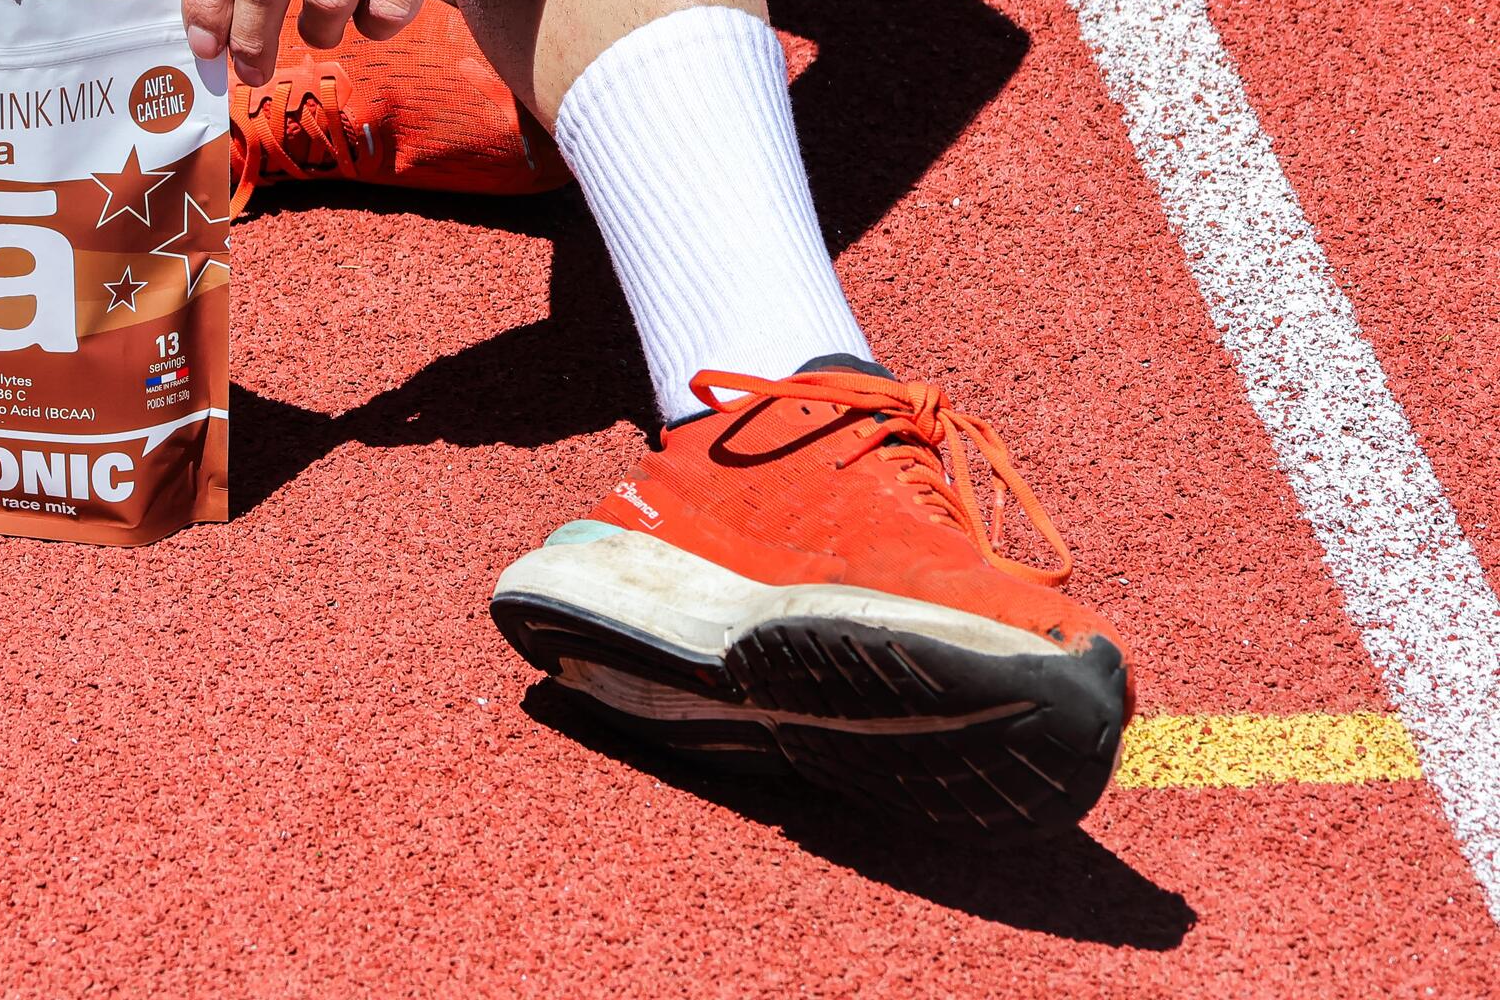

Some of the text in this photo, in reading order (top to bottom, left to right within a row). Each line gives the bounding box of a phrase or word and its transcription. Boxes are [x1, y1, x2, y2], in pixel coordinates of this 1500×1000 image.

[144, 74, 174, 99] AVEC
[60, 77, 115, 125] MIX
[136, 93, 187, 123] CAFÉINE
[155, 332, 180, 358] 13
[149, 355, 186, 374] servings
[145, 375, 189, 394] MADE IN FRANCE
[16, 390, 27, 401] C
[146, 396, 165, 410] POIDS
[10, 405, 41, 418] Acid
[44, 406, 96, 421] (BCAA)
[2, 497, 41, 511] race
[45, 501, 77, 516] mix
